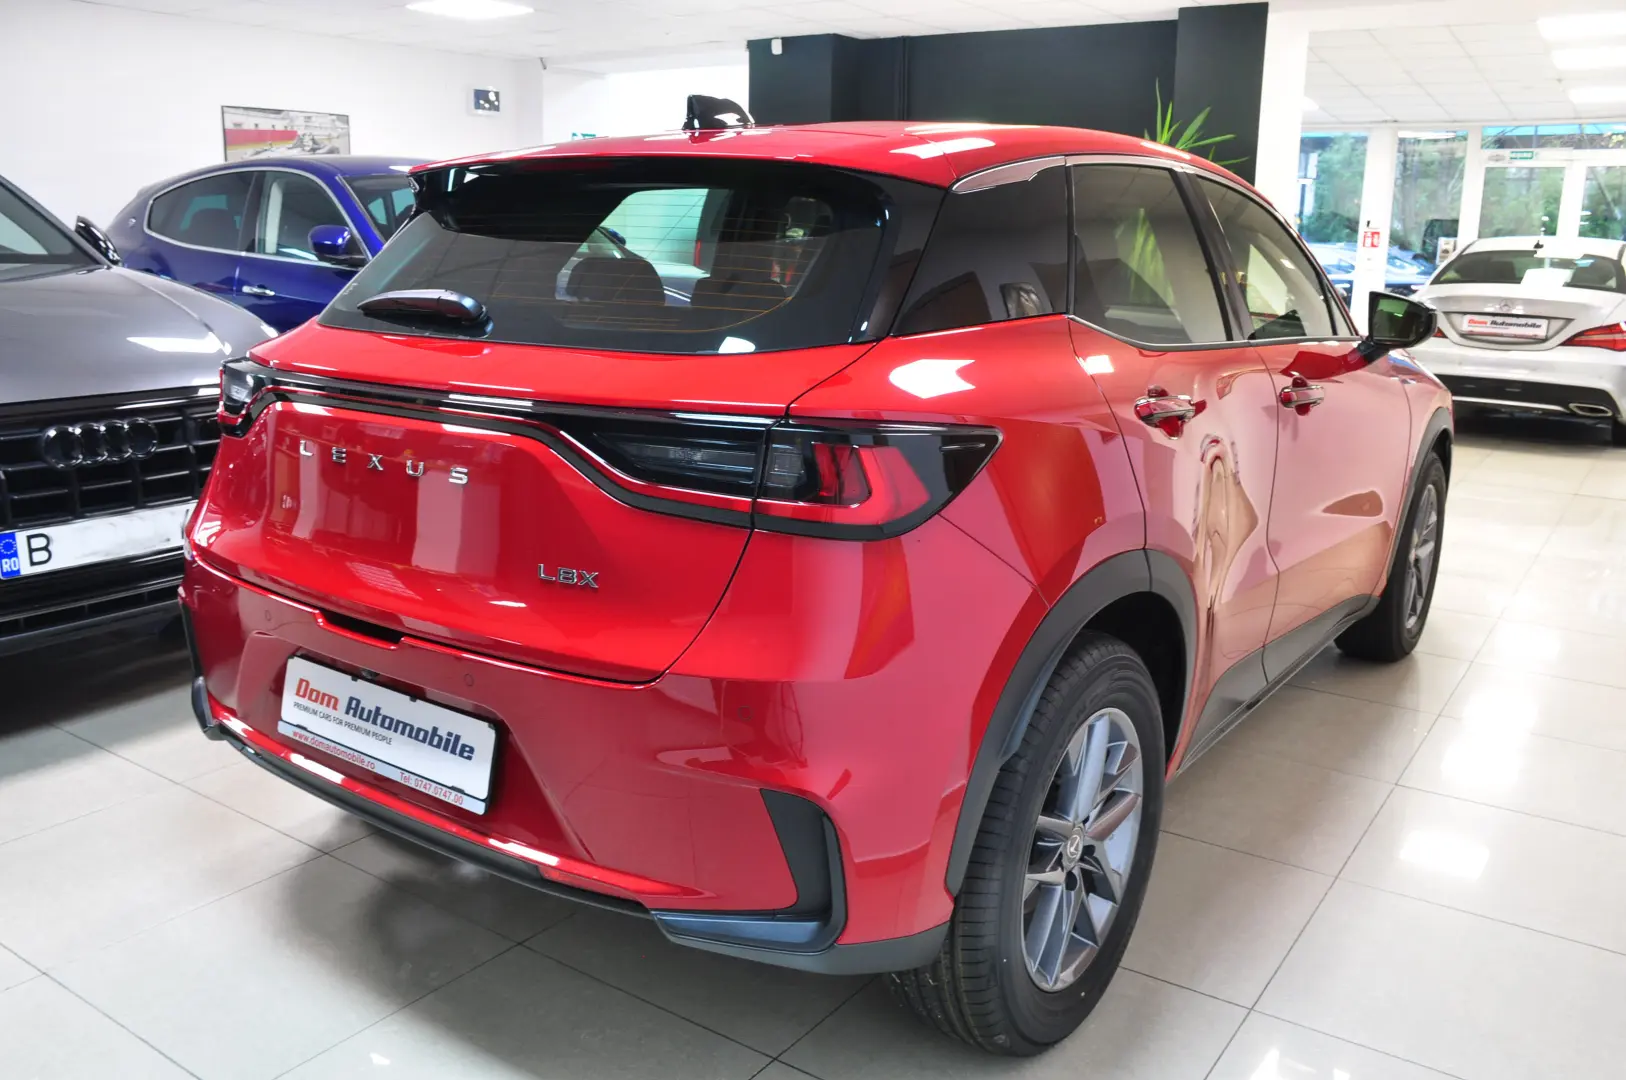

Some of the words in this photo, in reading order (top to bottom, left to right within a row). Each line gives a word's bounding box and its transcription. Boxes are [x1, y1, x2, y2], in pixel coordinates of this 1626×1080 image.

[299, 439, 469, 485] LEXUS
[2, 558, 19, 573] RO
[26, 532, 53, 567] B
[538, 563, 599, 588] LBX
[293, 701, 318, 716] PREMIUM
[318, 711, 332, 722] CARS
[333, 716, 344, 726] FOR
[344, 720, 371, 737] PREMIUM
[371, 732, 393, 746] PEOPLE
[295, 677, 339, 711] Dom
[344, 696, 475, 761] Automobile
[292, 730, 376, 770] www.domautomobile.ro
[399, 771, 413, 785] Tel:
[414, 778, 464, 806] 0747.0747.00
